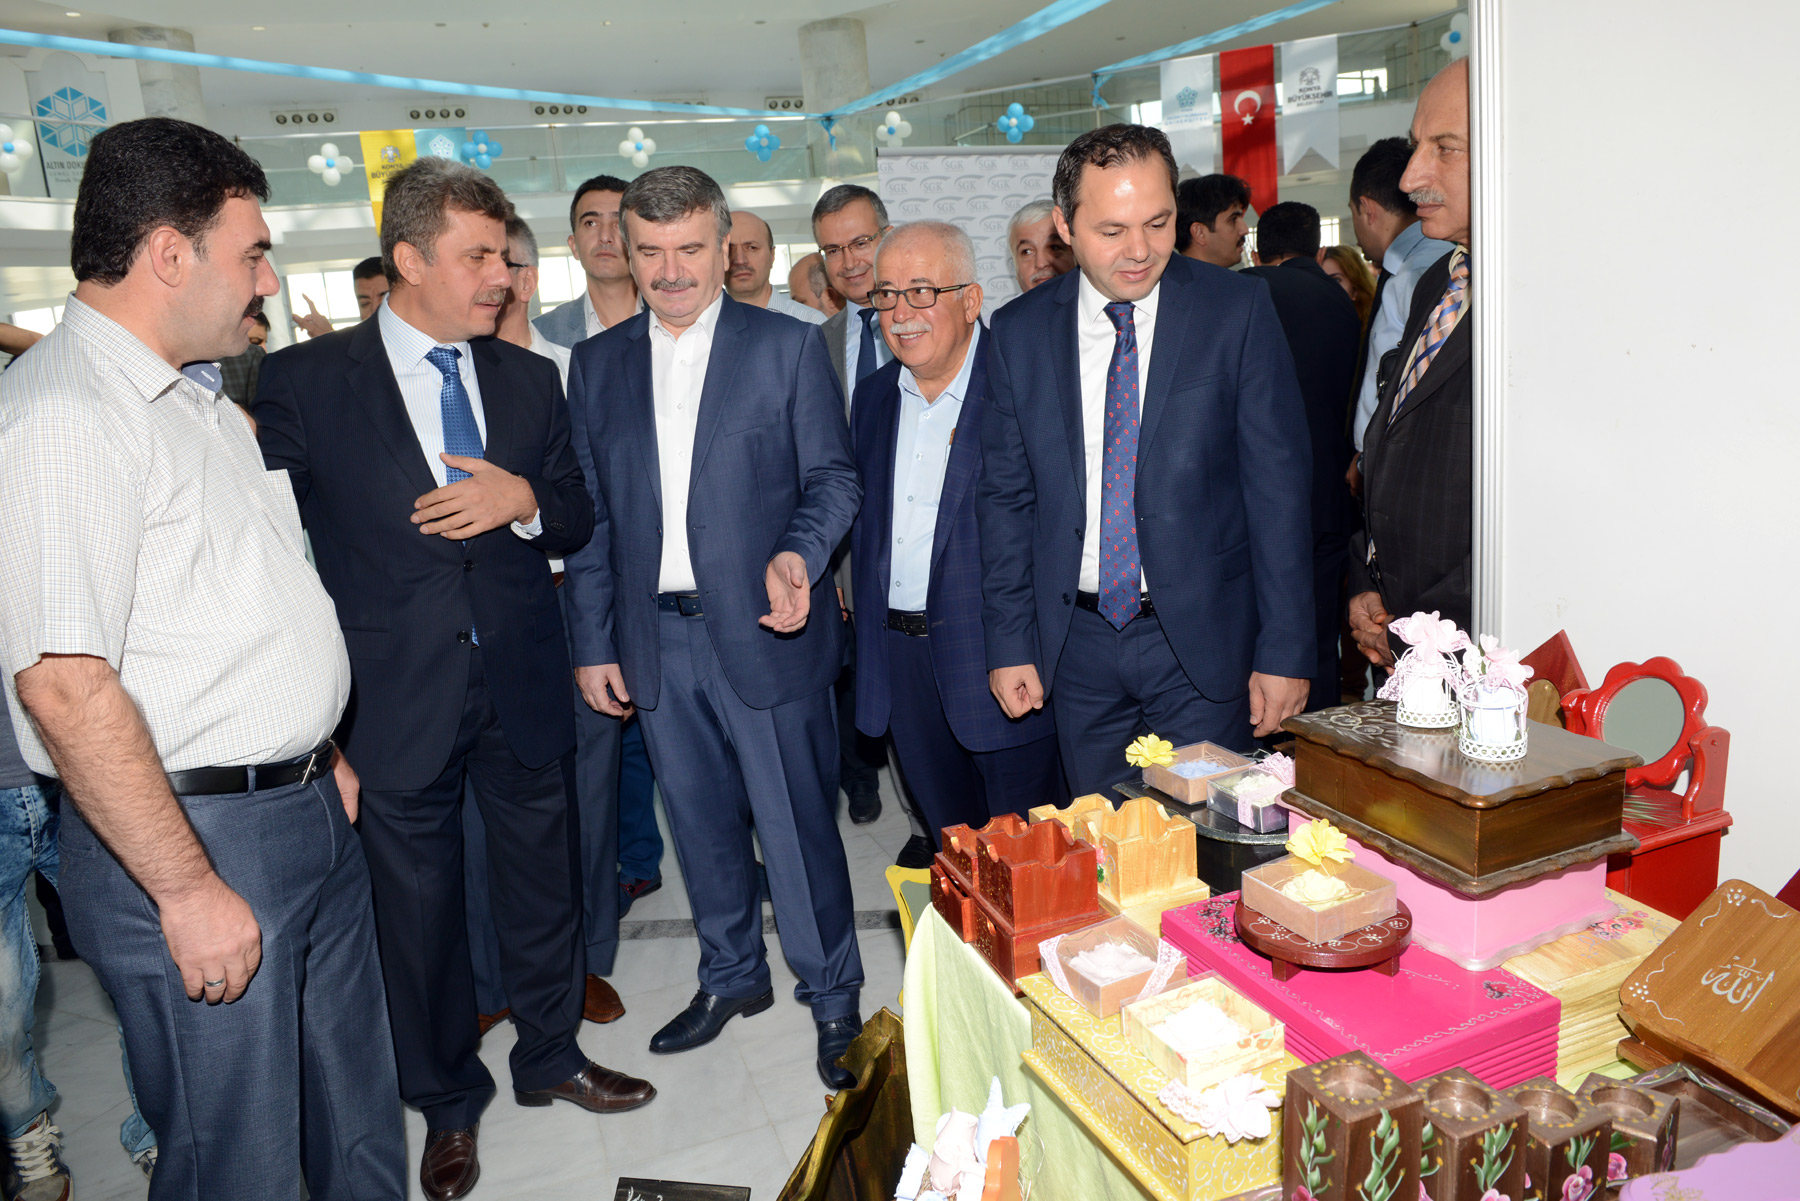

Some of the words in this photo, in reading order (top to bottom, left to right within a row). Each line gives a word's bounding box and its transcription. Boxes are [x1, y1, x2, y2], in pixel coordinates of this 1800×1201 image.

[47, 161, 65, 169] ALTIN
[910, 161, 930, 171] SGK
[944, 160, 964, 170] SGK
[979, 159, 998, 169] SGK
[1011, 158, 1030, 168] SGK
[888, 183, 908, 193] SGK
[923, 182, 943, 192] SGK
[957, 180, 977, 190] SGK
[991, 179, 1010, 190] SGK
[1023, 178, 1042, 189] SGK
[902, 203, 921, 214] SGK
[936, 202, 956, 212] SGK
[970, 200, 990, 211] SGK
[983, 220, 1004, 230] SGK
[990, 281, 1010, 290] SGK
